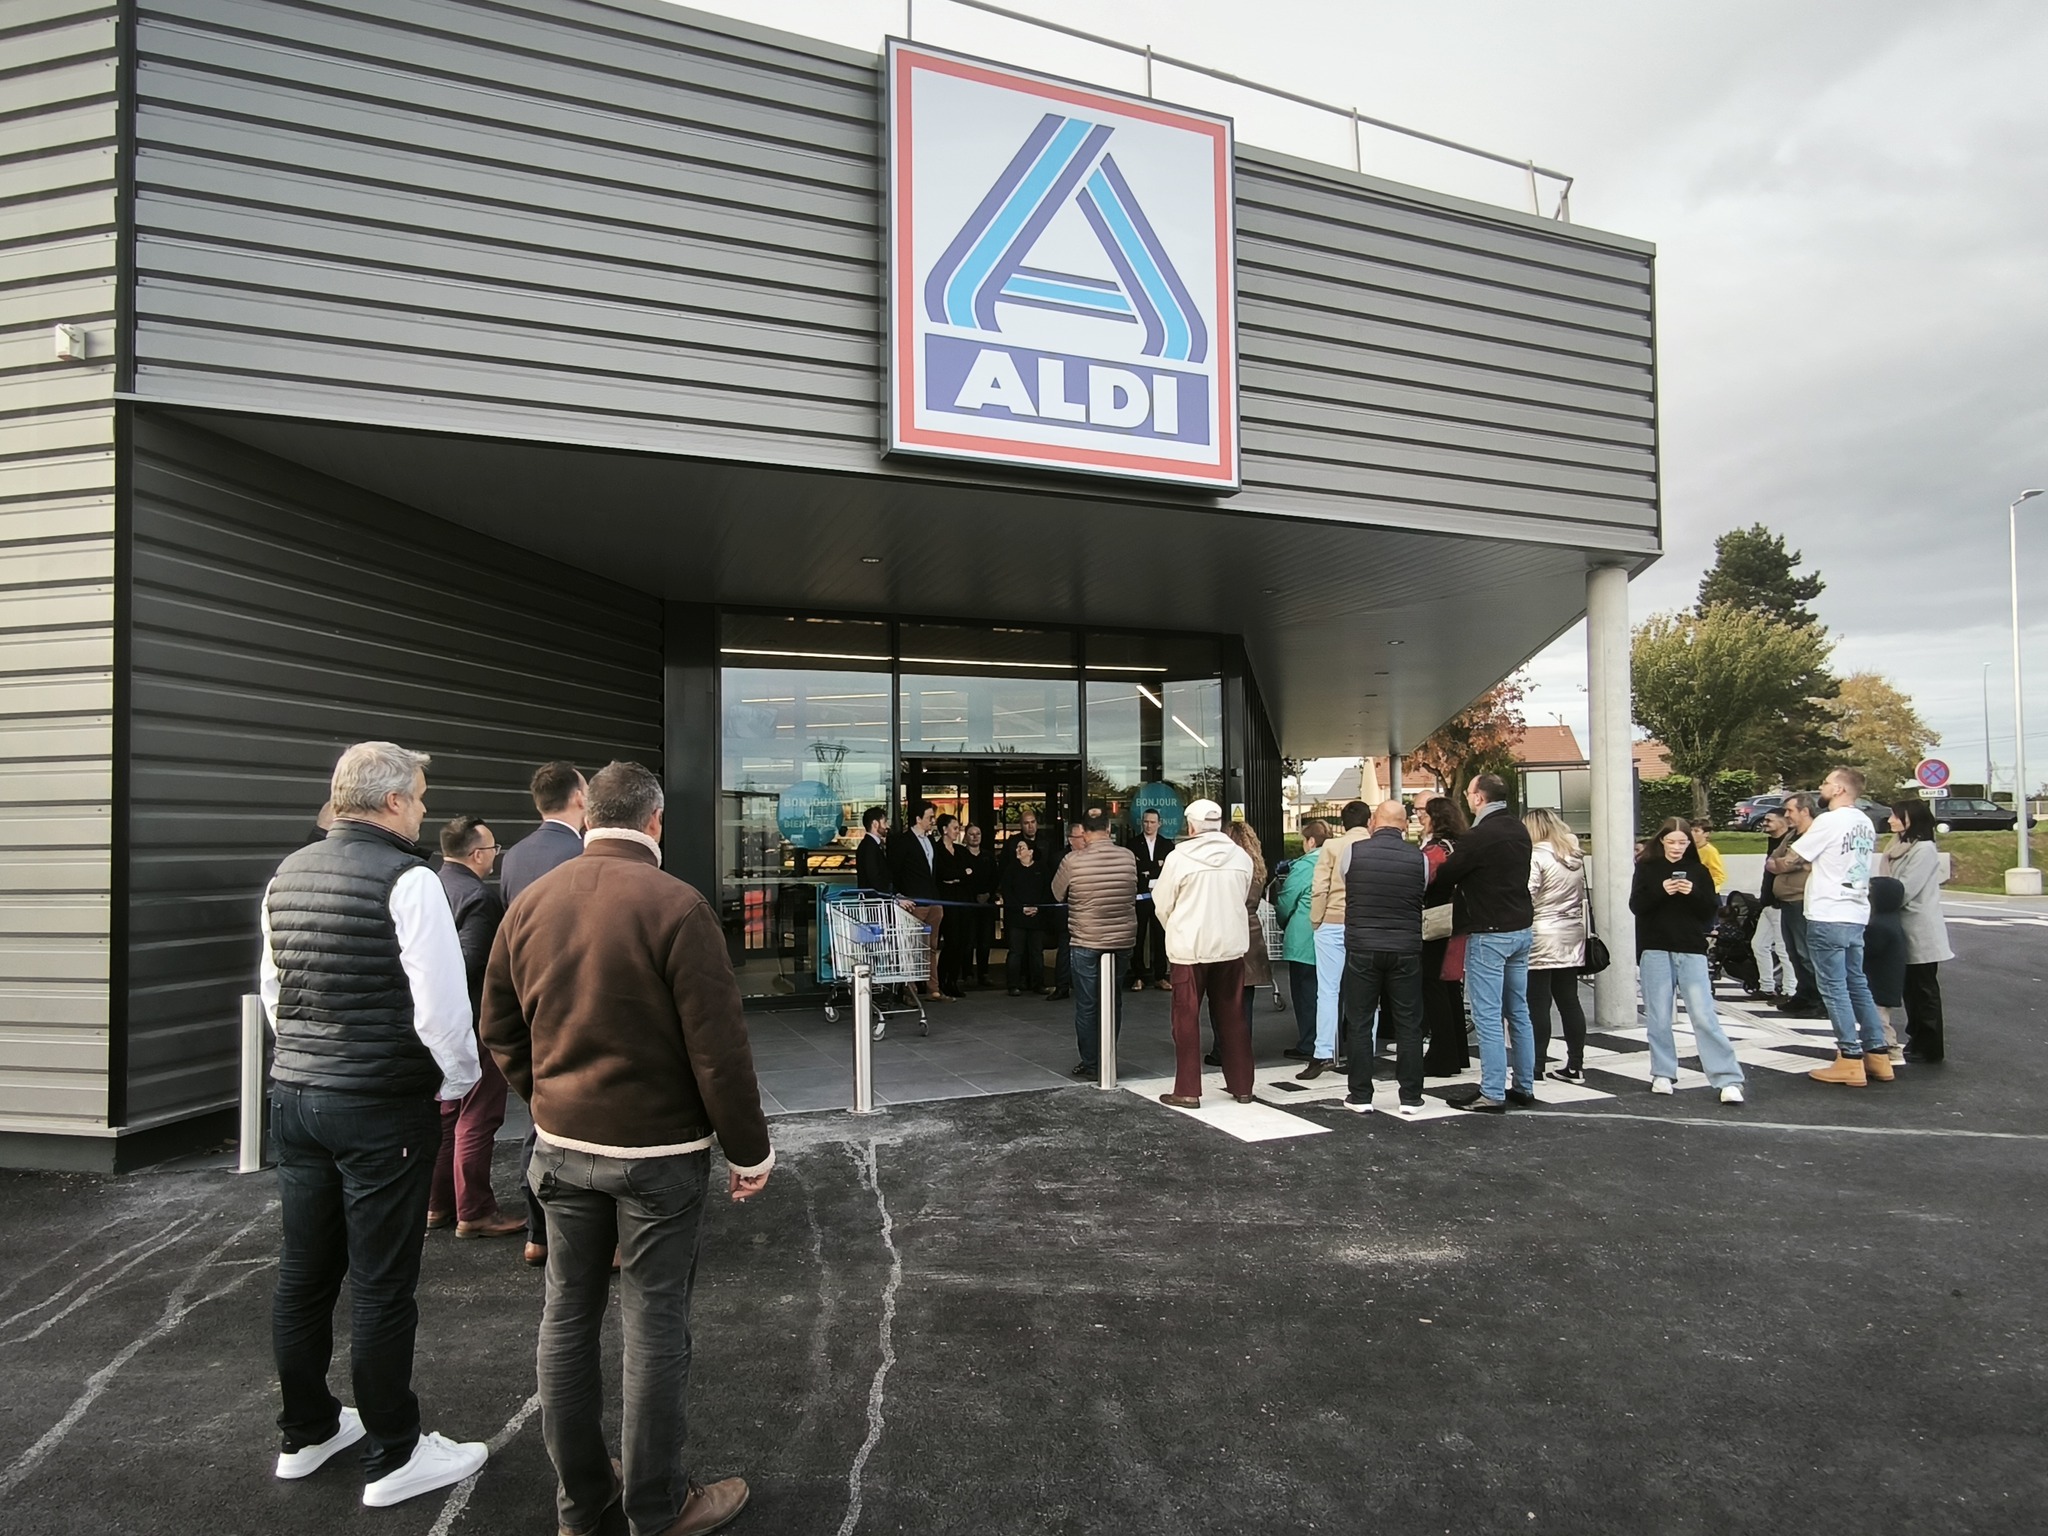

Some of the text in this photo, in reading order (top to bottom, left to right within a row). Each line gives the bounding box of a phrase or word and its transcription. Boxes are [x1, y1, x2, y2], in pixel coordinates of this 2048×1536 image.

[953, 348, 1179, 435] ALDI
[784, 797, 835, 807] BONJOUR
[1136, 798, 1177, 807] BONJOUR
